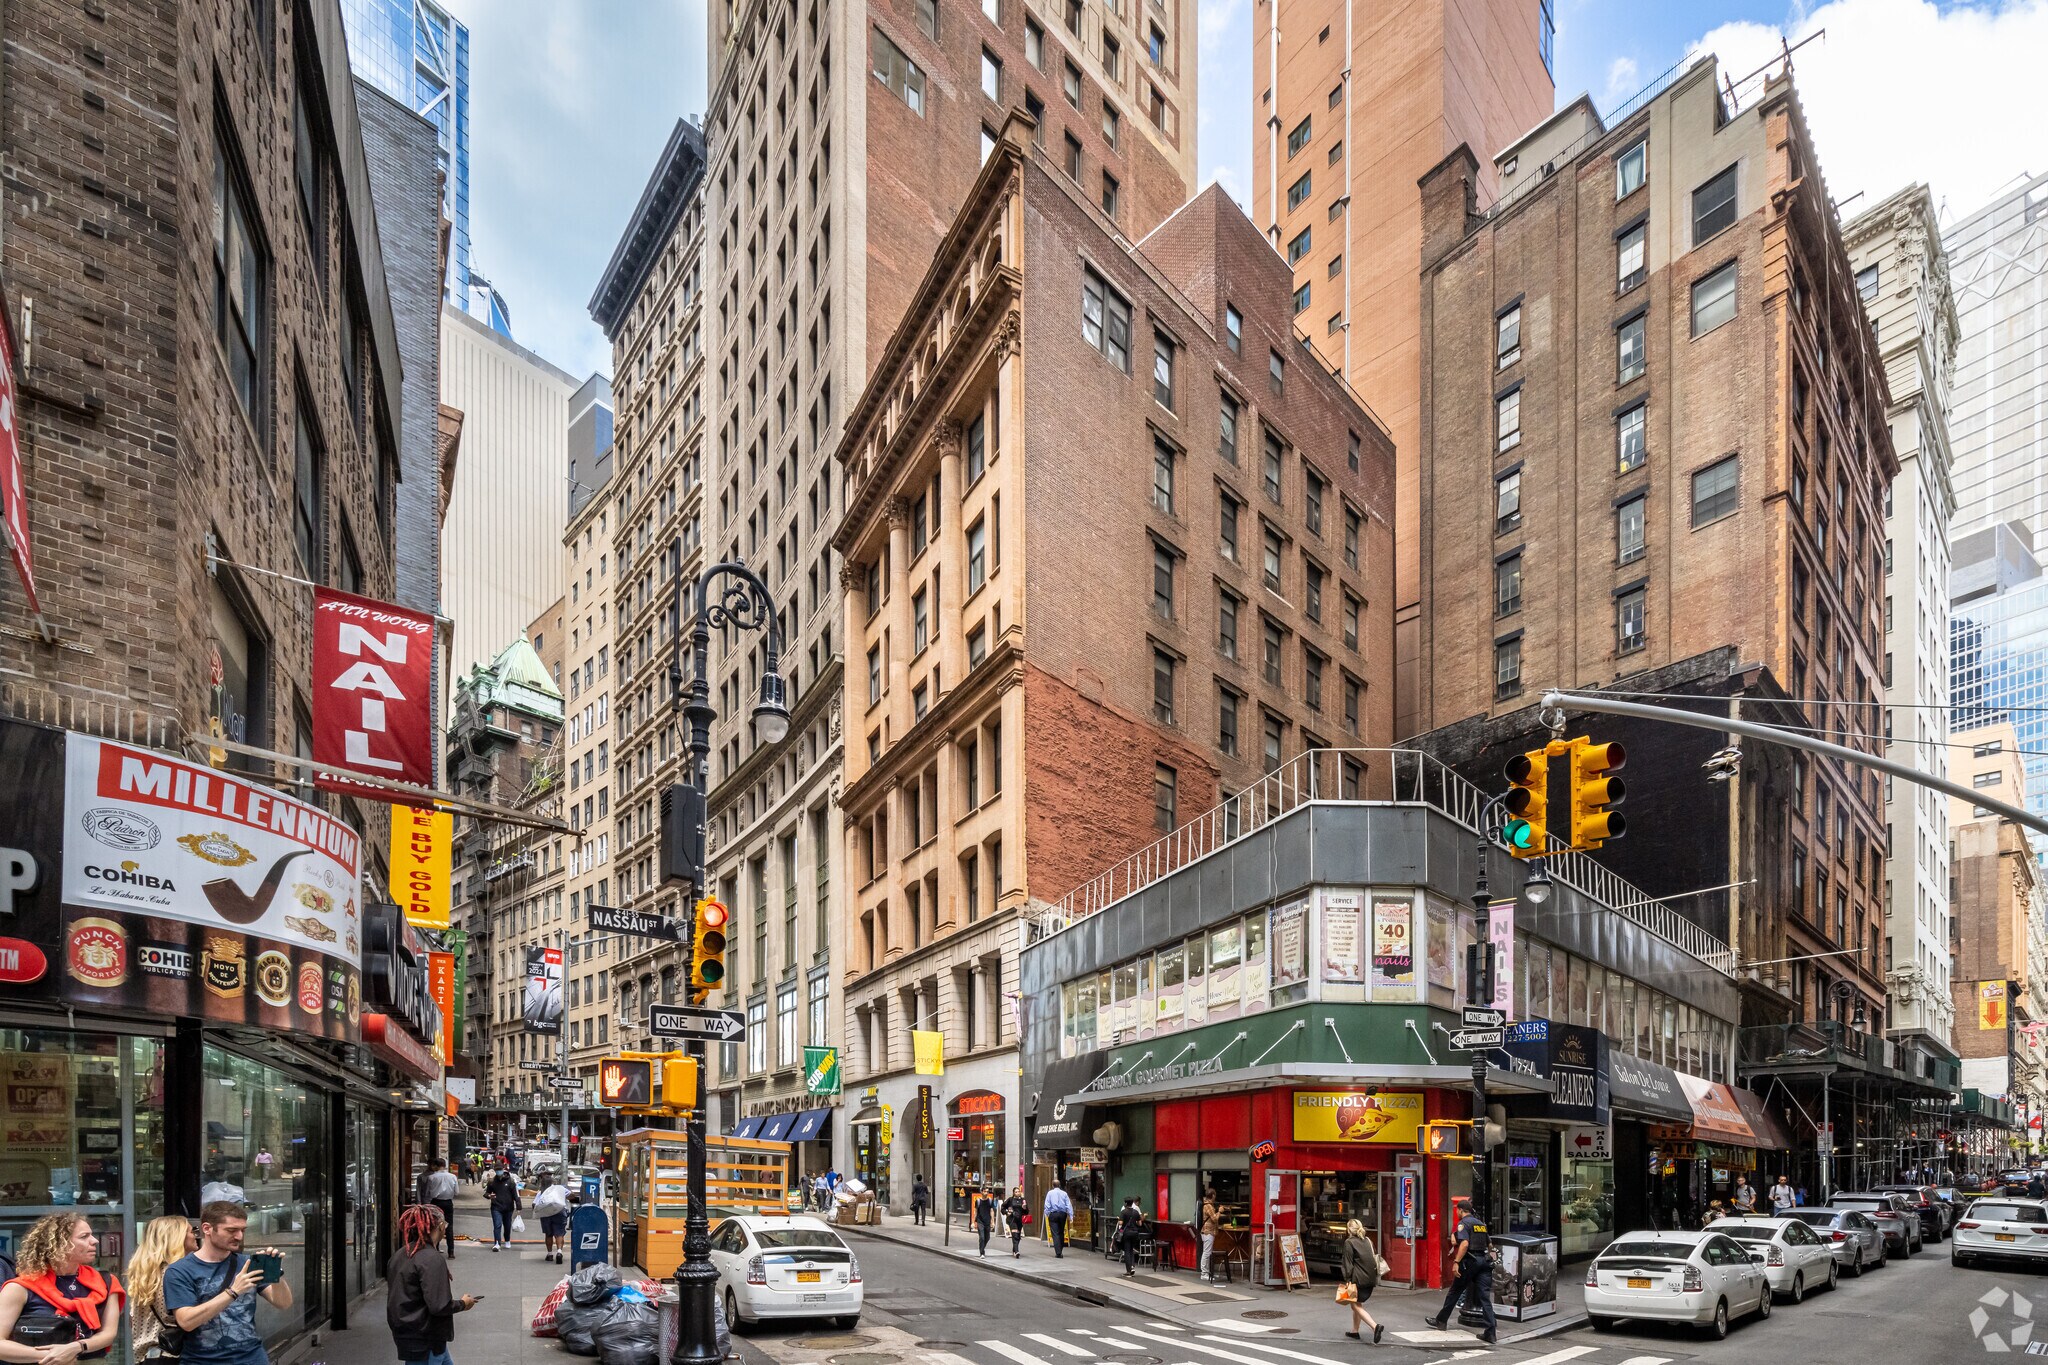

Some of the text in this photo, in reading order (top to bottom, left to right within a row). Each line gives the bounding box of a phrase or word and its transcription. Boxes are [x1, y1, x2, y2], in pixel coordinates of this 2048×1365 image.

[319, 601, 431, 634] ANN WONG
[330, 622, 408, 771] NAIL
[119, 755, 355, 868] MILLENNIUM
[410, 832, 432, 864] BUY
[83, 865, 177, 893] COHIBA
[409, 871, 432, 914] GOLD
[593, 911, 658, 932] NASSAU ST
[1379, 924, 1405, 938] $40
[73, 930, 122, 950] PUNCH
[138, 948, 193, 969] COHIB
[213, 962, 235, 973] HOYO
[1375, 954, 1412, 967] nails
[1495, 920, 1508, 1002] NAILS
[76, 964, 121, 978] IMPORTED
[208, 971, 241, 986] MONTERREY
[528, 968, 543, 976] 2022
[437, 966, 446, 1005] KATI
[659, 1015, 733, 1033] ONE WAY
[1469, 1013, 1500, 1023] ONE WAY
[1505, 1022, 1548, 1035] EANERS
[1454, 1033, 1499, 1044] ONE WAY
[1558, 1050, 1588, 1066] SUNRISE
[806, 1048, 836, 1091] SUBWAY
[1092, 1057, 1223, 1091] FRIENDLY GOURMET PIZZA
[1614, 1064, 1641, 1086] Salon
[1637, 1070, 1651, 1089] De
[1550, 1070, 1595, 1108] CLEANERS
[922, 1087, 931, 1139] STICKY'S
[958, 1093, 1001, 1114] STICKY'S
[1298, 1096, 1419, 1109] FRIENDLY PIZZA
[1047, 1123, 1058, 1133] SHOE
[1252, 1140, 1275, 1159] OPEN
[1596, 1130, 1605, 1151] HAIR
